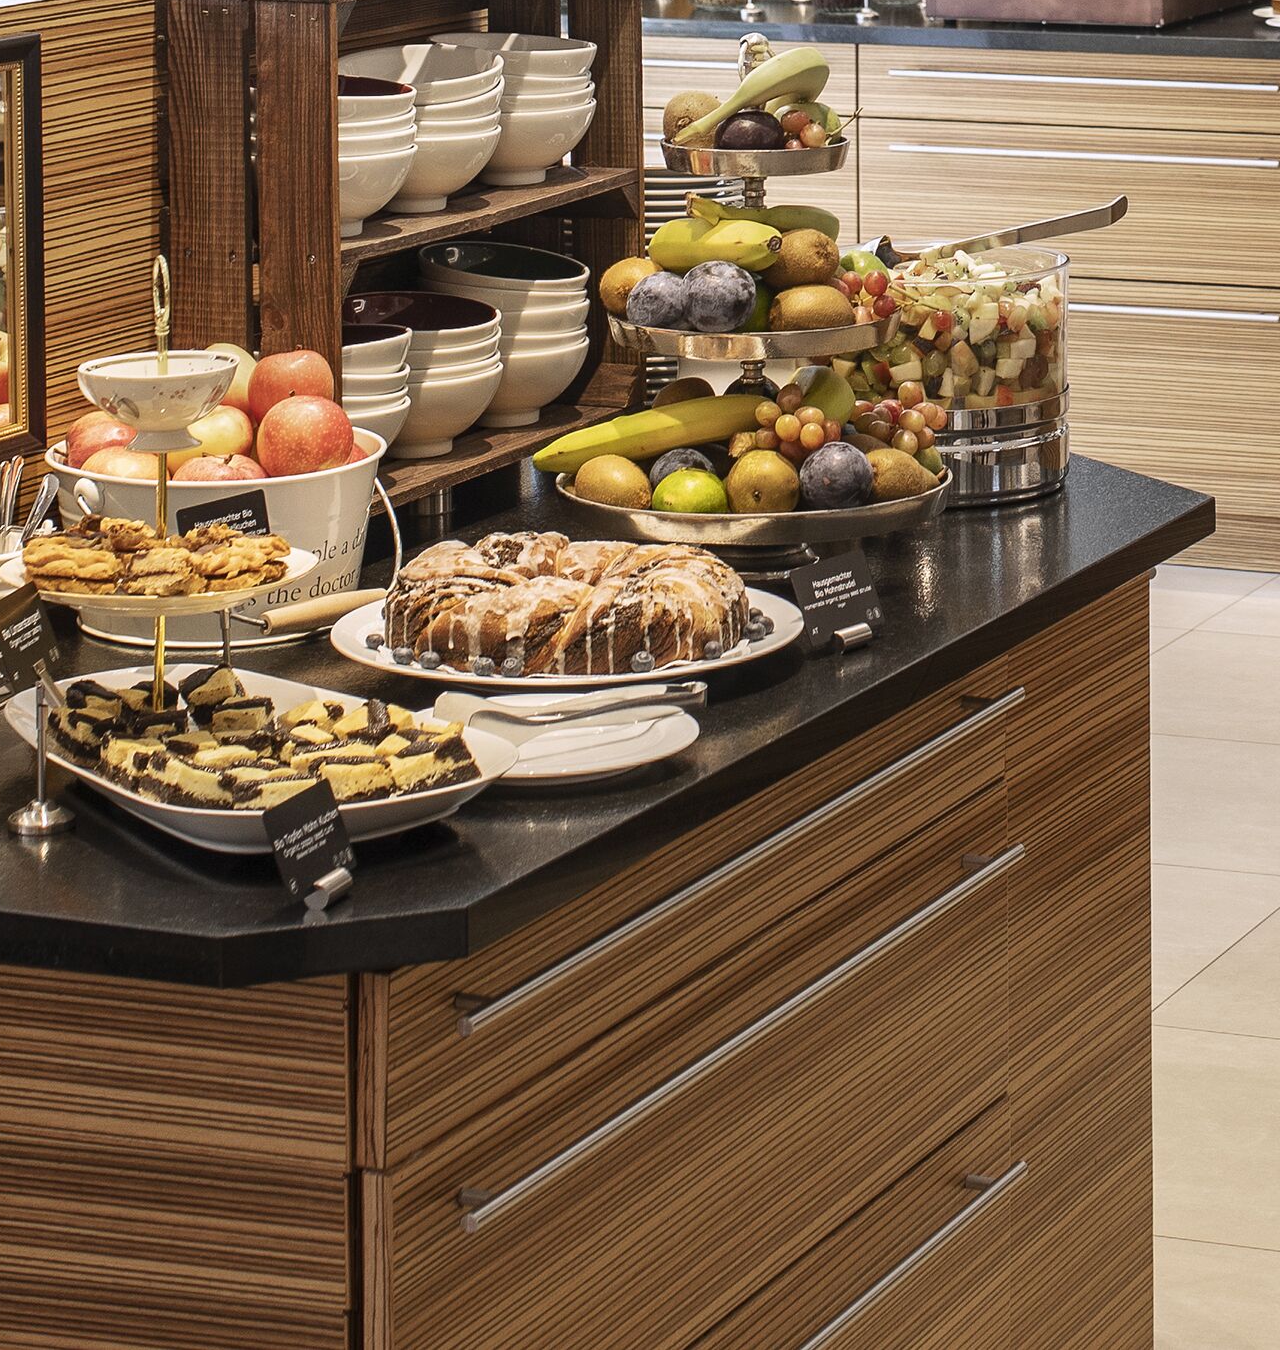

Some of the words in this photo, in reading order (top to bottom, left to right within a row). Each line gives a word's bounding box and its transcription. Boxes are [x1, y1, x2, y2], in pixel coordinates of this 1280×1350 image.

[242, 509, 253, 518] Bio
[267, 587, 302, 605] the
[309, 568, 356, 598] doctor
[814, 589, 824, 599] Bio
